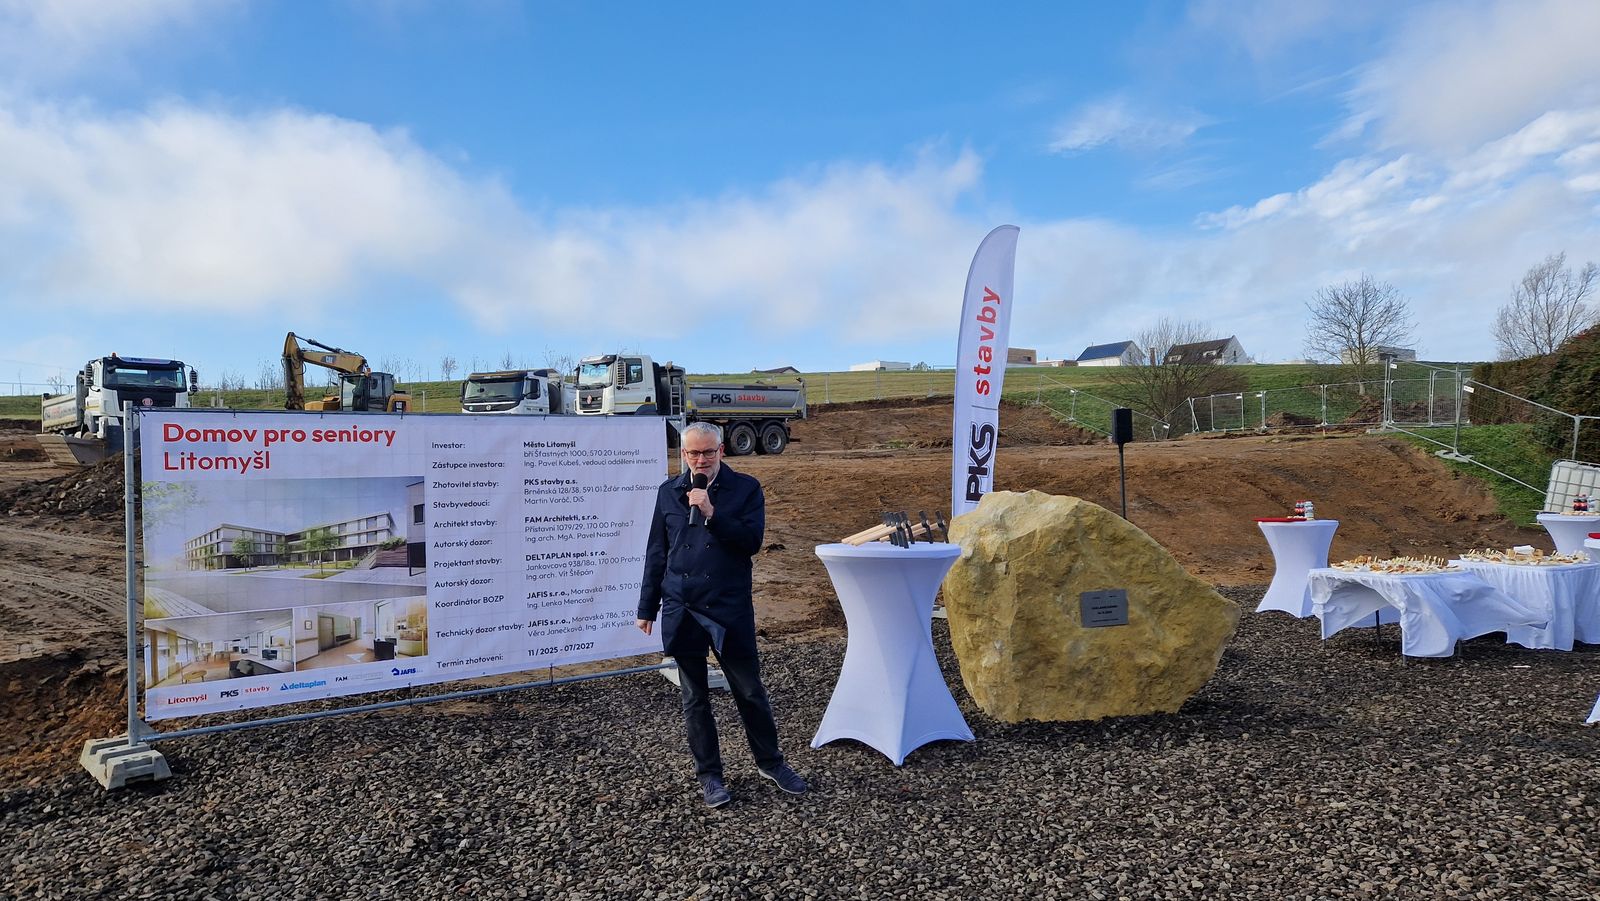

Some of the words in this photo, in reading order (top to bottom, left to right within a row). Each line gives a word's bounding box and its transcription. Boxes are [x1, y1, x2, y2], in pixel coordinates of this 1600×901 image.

[973, 286, 1000, 396] stavby
[711, 394, 731, 404] PKS
[164, 424, 257, 442] Domov
[264, 429, 306, 446] pro
[312, 425, 396, 446] seniory
[164, 450, 270, 474] Litomyšl
[966, 424, 995, 501] PKS
[433, 500, 490, 509] Stavbyvedoucí:
[470, 519, 498, 527] stavby:
[434, 540, 468, 549] Autorský
[526, 552, 571, 561] DELTAPLAN
[434, 560, 474, 569] Projektant
[570, 569, 593, 577] Štěpán
[435, 578, 468, 588] Autorský
[571, 587, 602, 595] Moravská
[435, 598, 481, 608] Koordinátor
[483, 595, 504, 603] BOZP
[527, 601, 539, 609] Ing.
[528, 619, 548, 628] JAFIS
[572, 614, 604, 622] Moravská
[436, 628, 474, 638] Technický
[476, 626, 496, 634] dozor
[586, 623, 598, 632] Ing.
[564, 641, 594, 651] 07/2027
[437, 659, 464, 668] Termín
[466, 654, 504, 665] zhotovení:
[289, 678, 326, 690] deltaplan
[220, 689, 238, 698] PKS
[168, 694, 207, 704] Litomyšl
